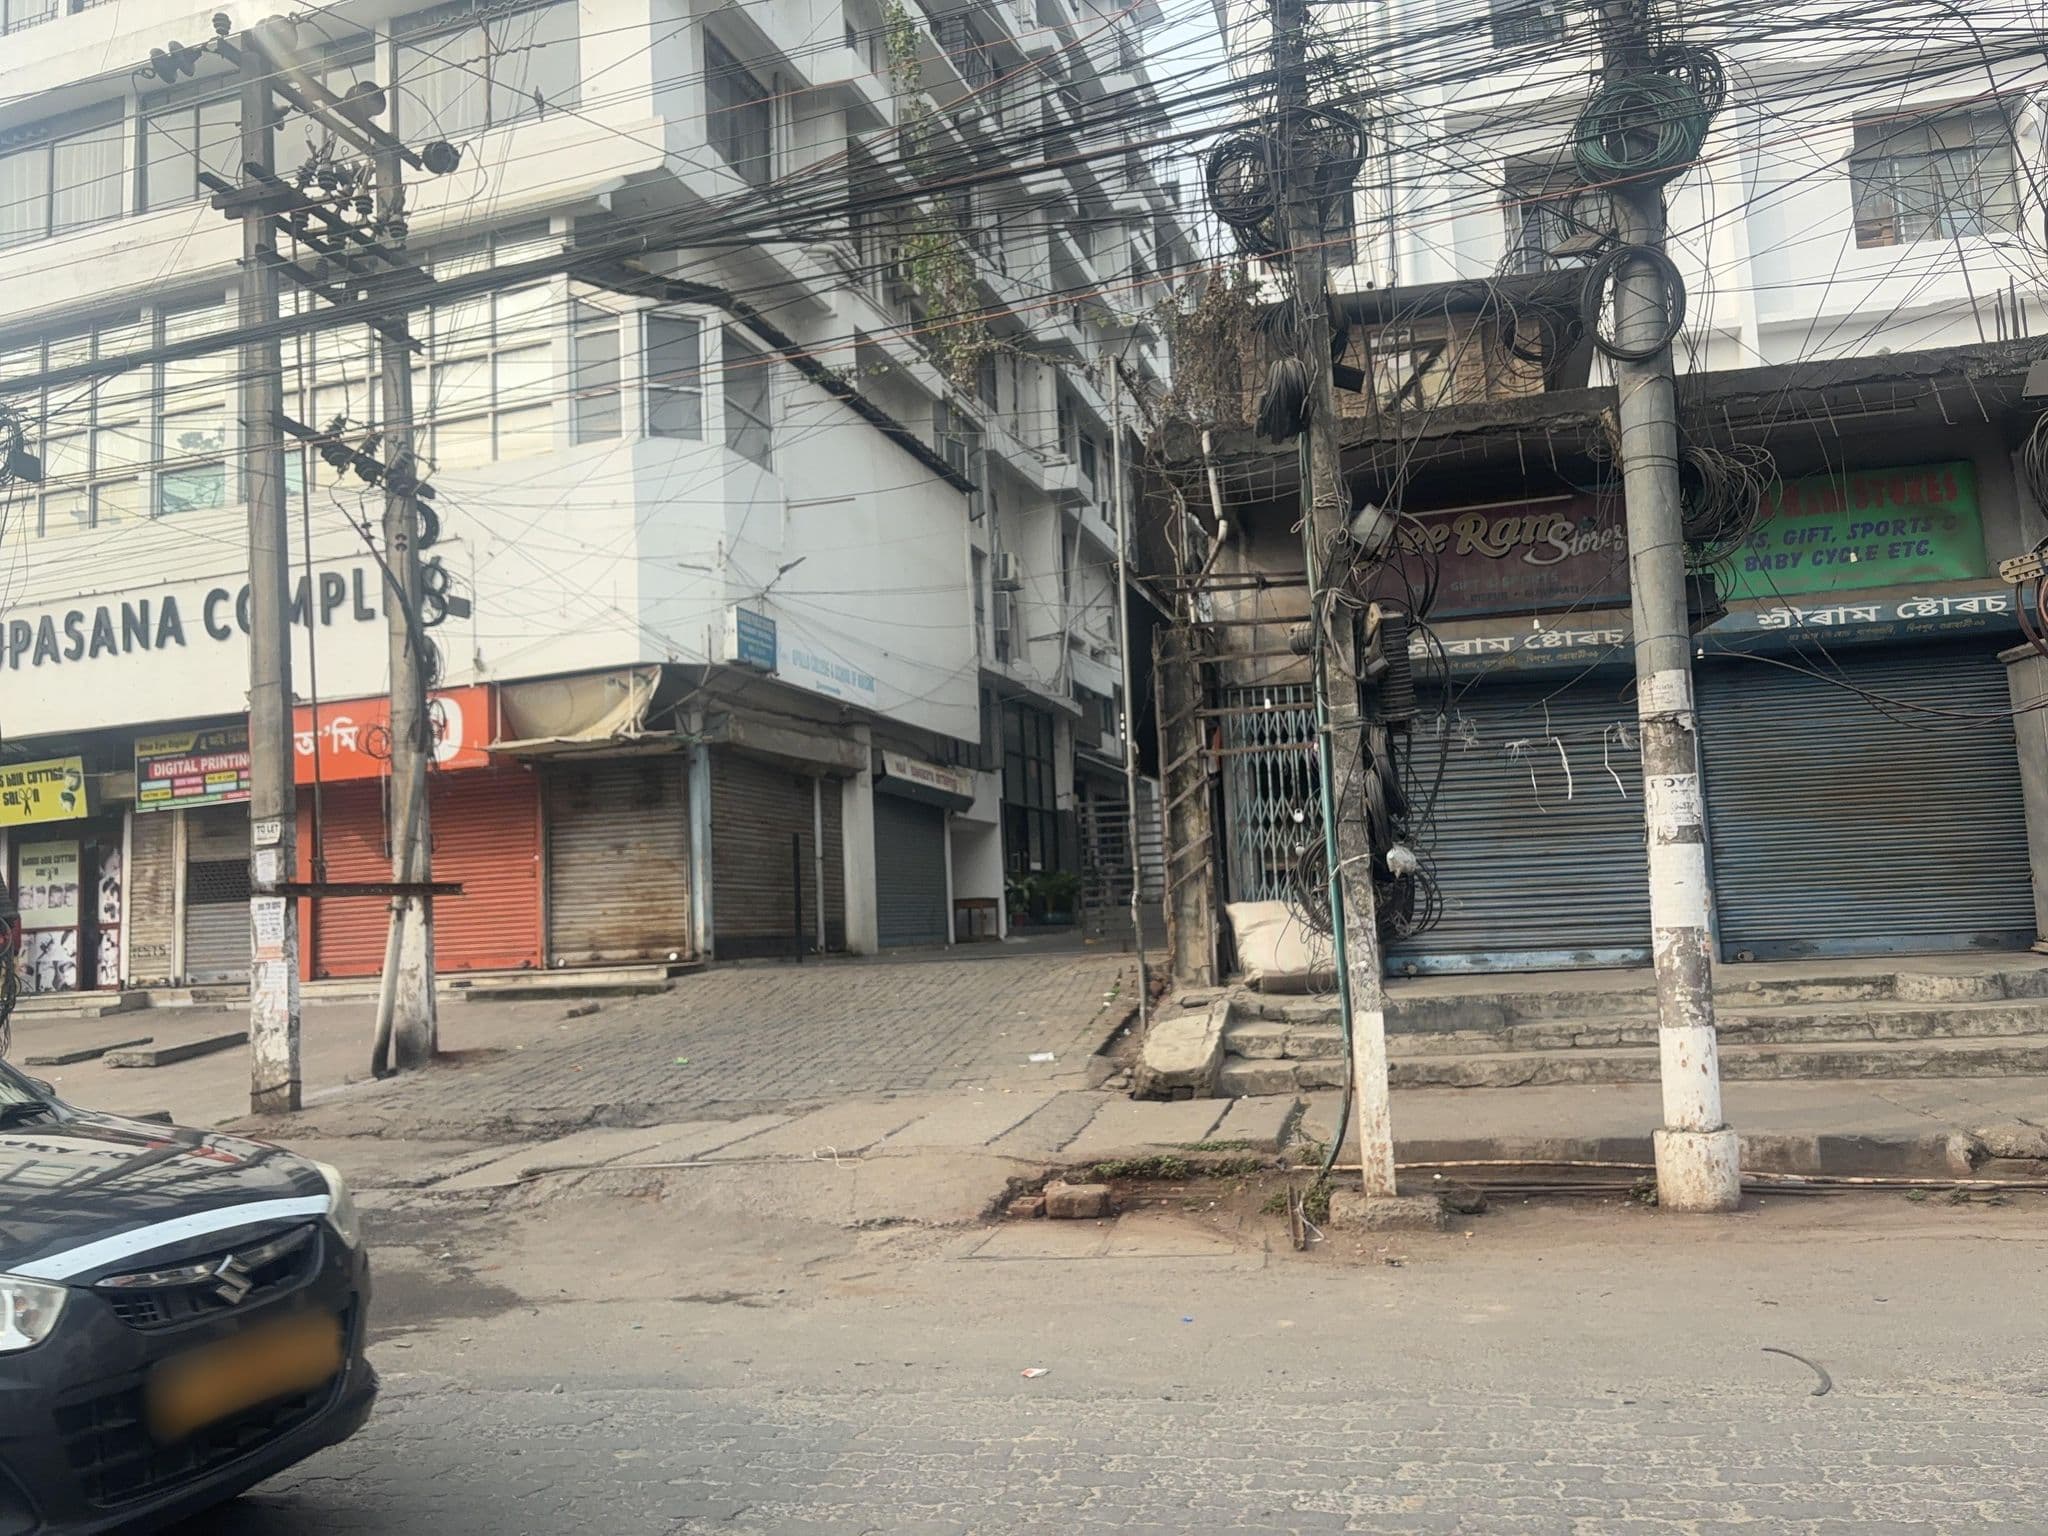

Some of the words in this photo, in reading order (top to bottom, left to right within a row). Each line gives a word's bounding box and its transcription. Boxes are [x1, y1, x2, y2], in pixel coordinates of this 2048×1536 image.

[1453, 512, 1567, 558] Ram
[1783, 525, 1836, 545] GIFT,
[1847, 517, 1933, 540] SPORTS
[1744, 552, 1803, 572] BABY
[1888, 540, 1934, 559] ETC.
[0, 596, 187, 673] PASANA
[153, 759, 198, 777] DIGITAL
[201, 752, 250, 771] PRINTIN
[256, 825, 266, 833] TO
[267, 823, 279, 834] LET
